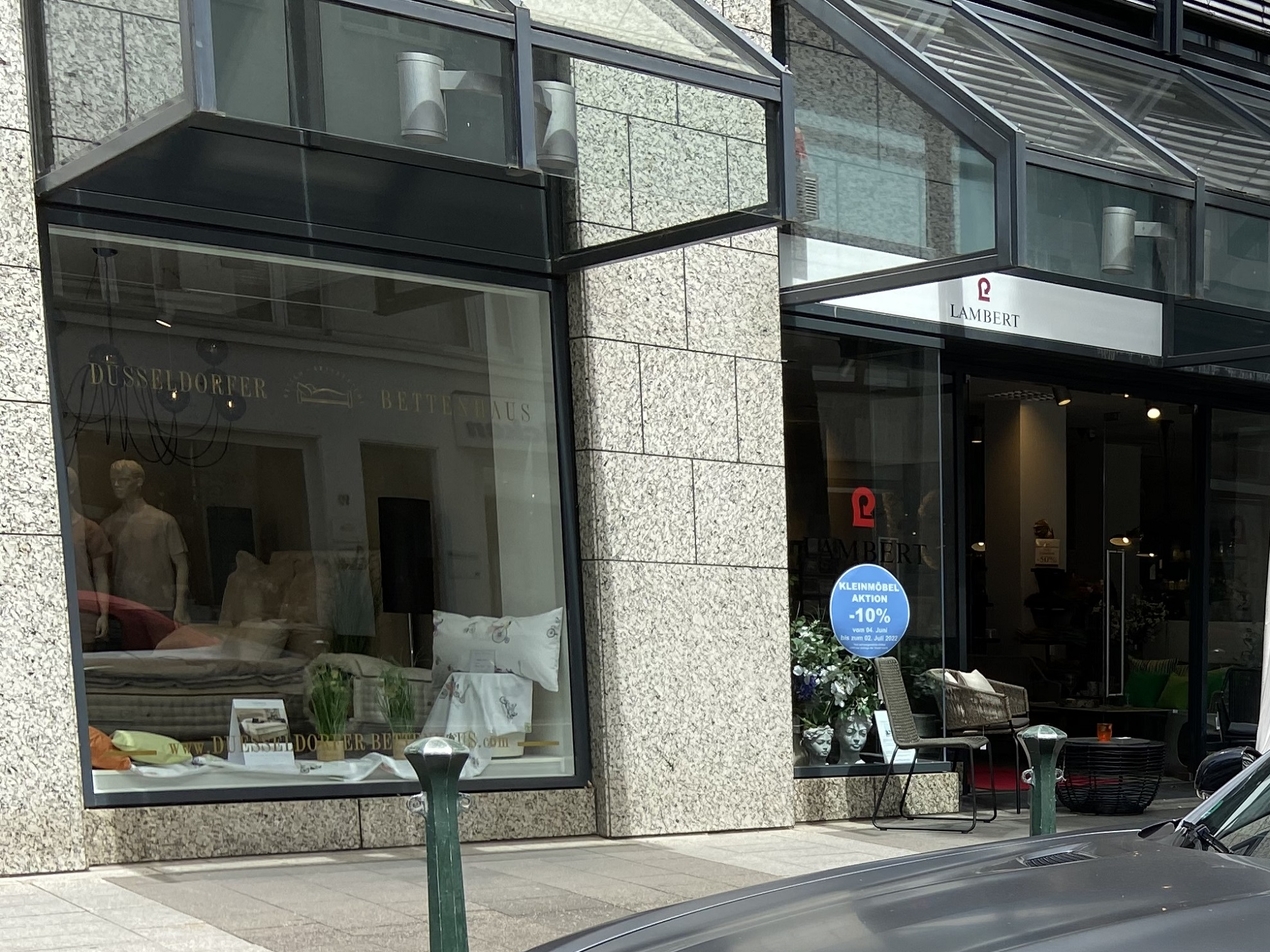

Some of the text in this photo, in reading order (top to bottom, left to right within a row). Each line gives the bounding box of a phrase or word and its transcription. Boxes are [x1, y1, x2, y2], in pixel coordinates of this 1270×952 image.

[950, 303, 1020, 328] LAMBERT
[803, 537, 927, 564] LAMBERT
[839, 581, 899, 592] KLEINMÖBEL
[852, 594, 888, 603] AKTION
[849, 608, 891, 623] -10%
[876, 626, 888, 634] Juni
